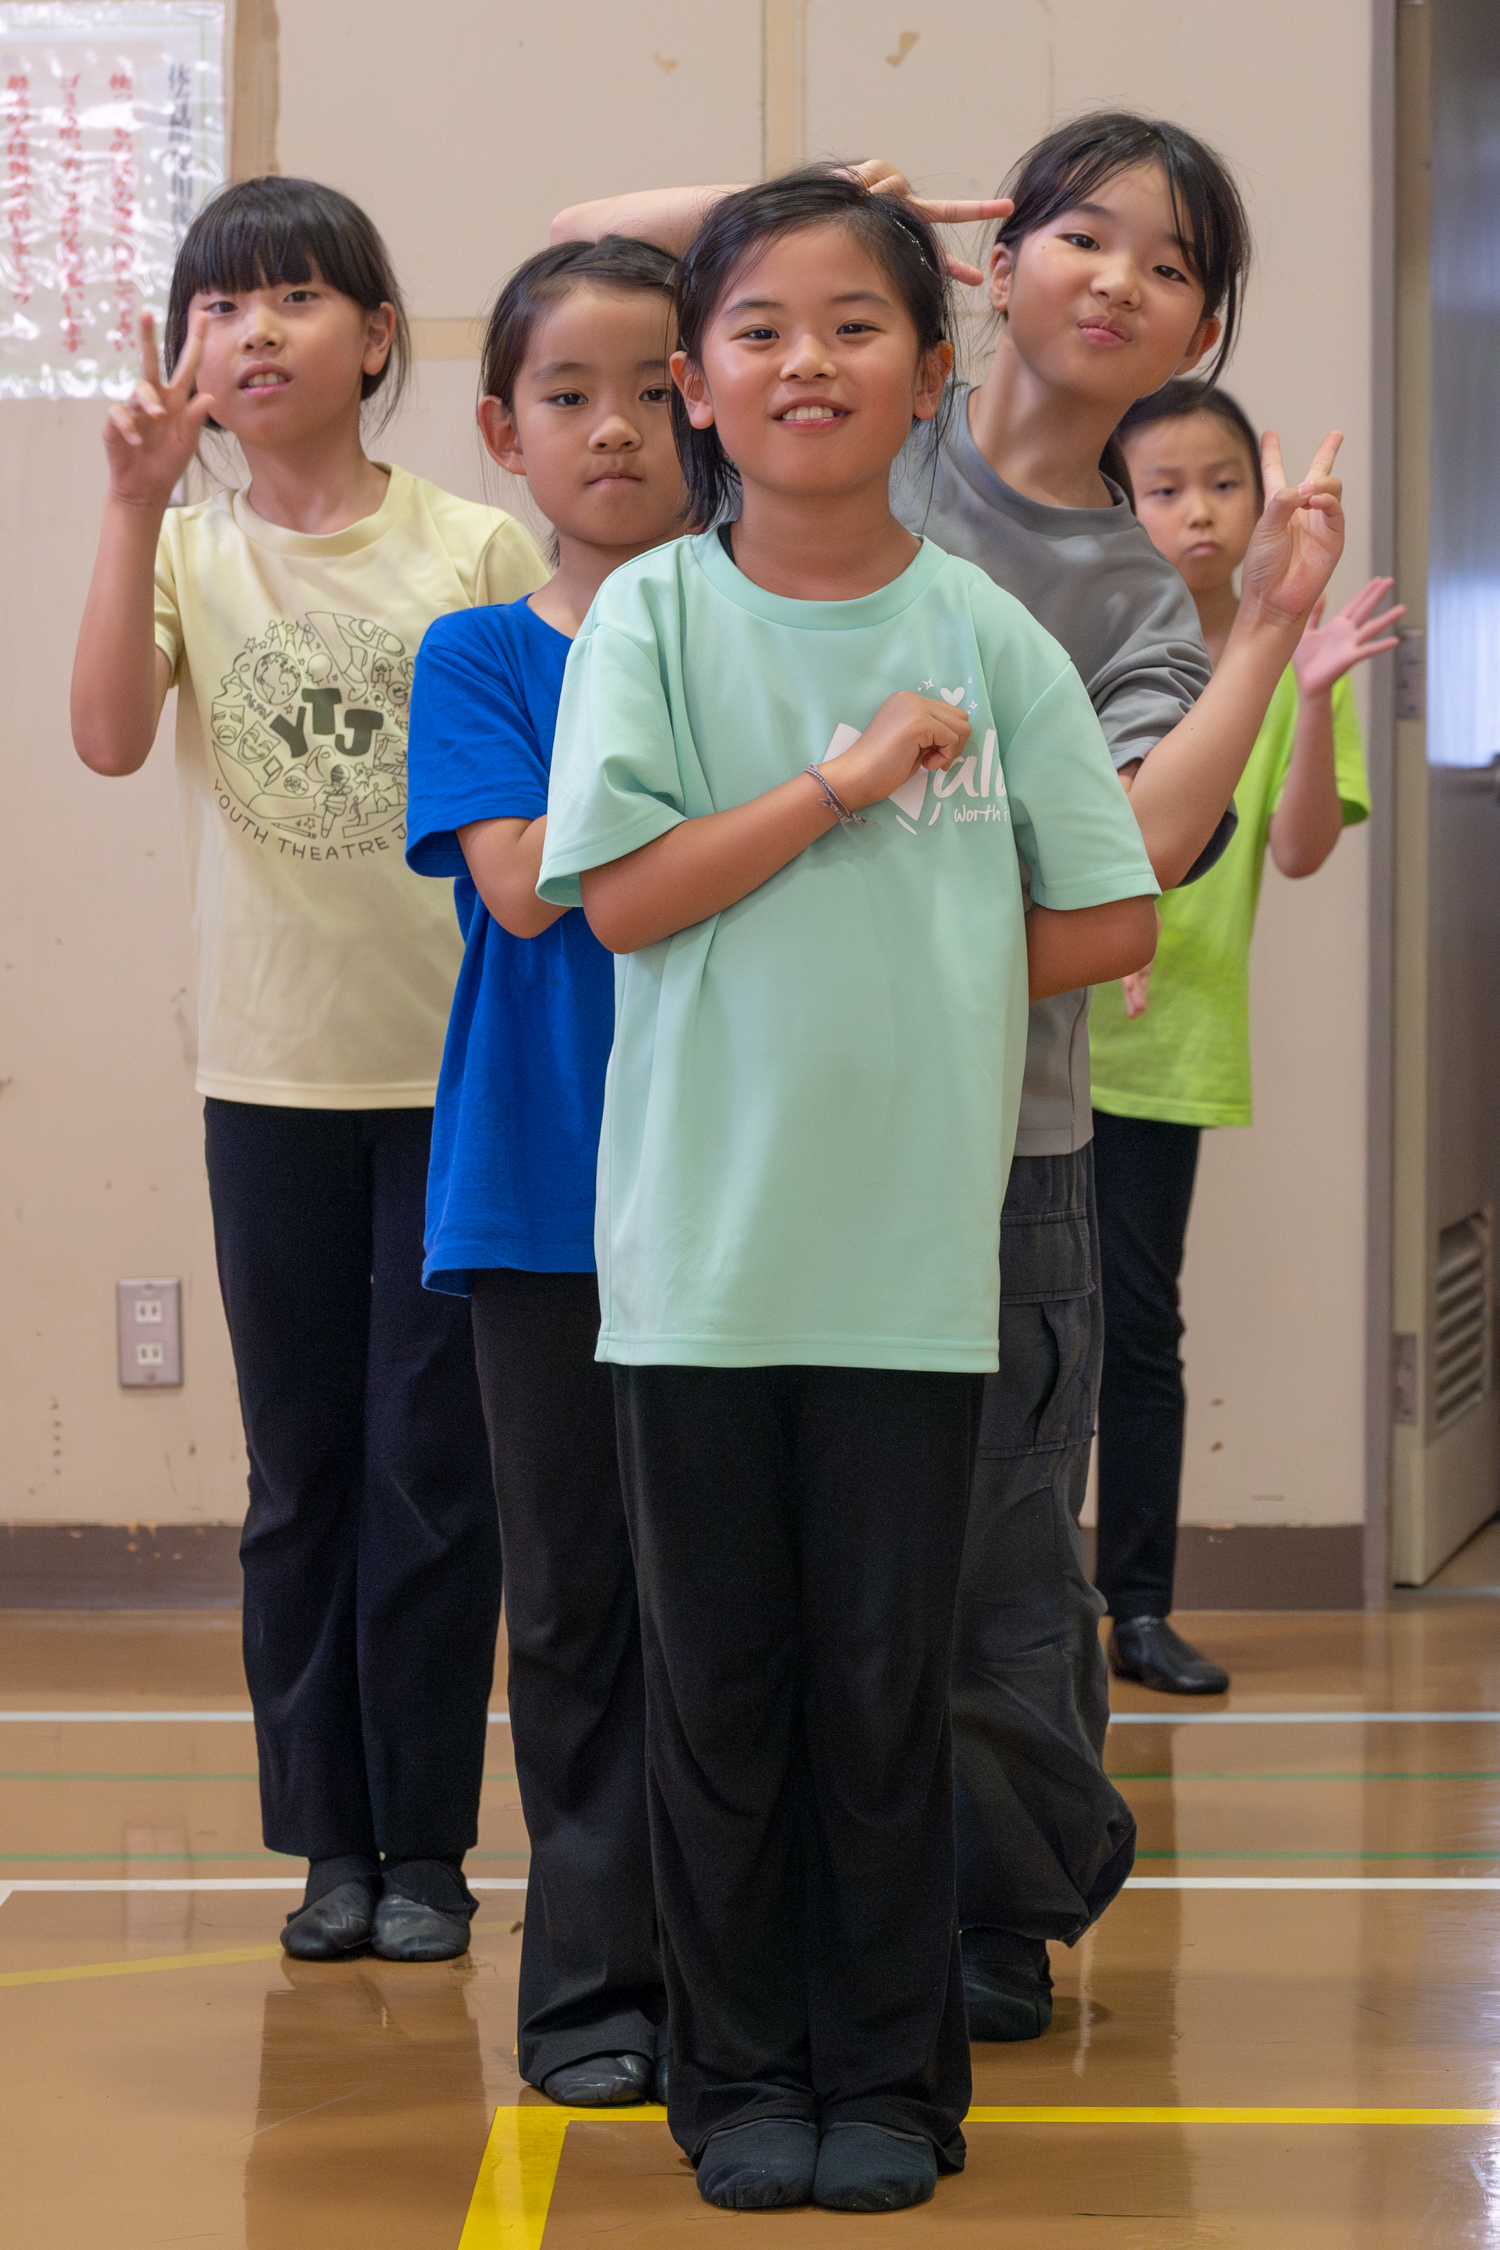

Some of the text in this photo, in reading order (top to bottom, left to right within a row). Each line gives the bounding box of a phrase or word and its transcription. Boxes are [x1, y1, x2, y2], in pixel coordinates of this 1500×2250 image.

[269, 688, 384, 758] YTJ
[954, 804, 1001, 822] worth
[278, 836, 389, 861] THEATRE
